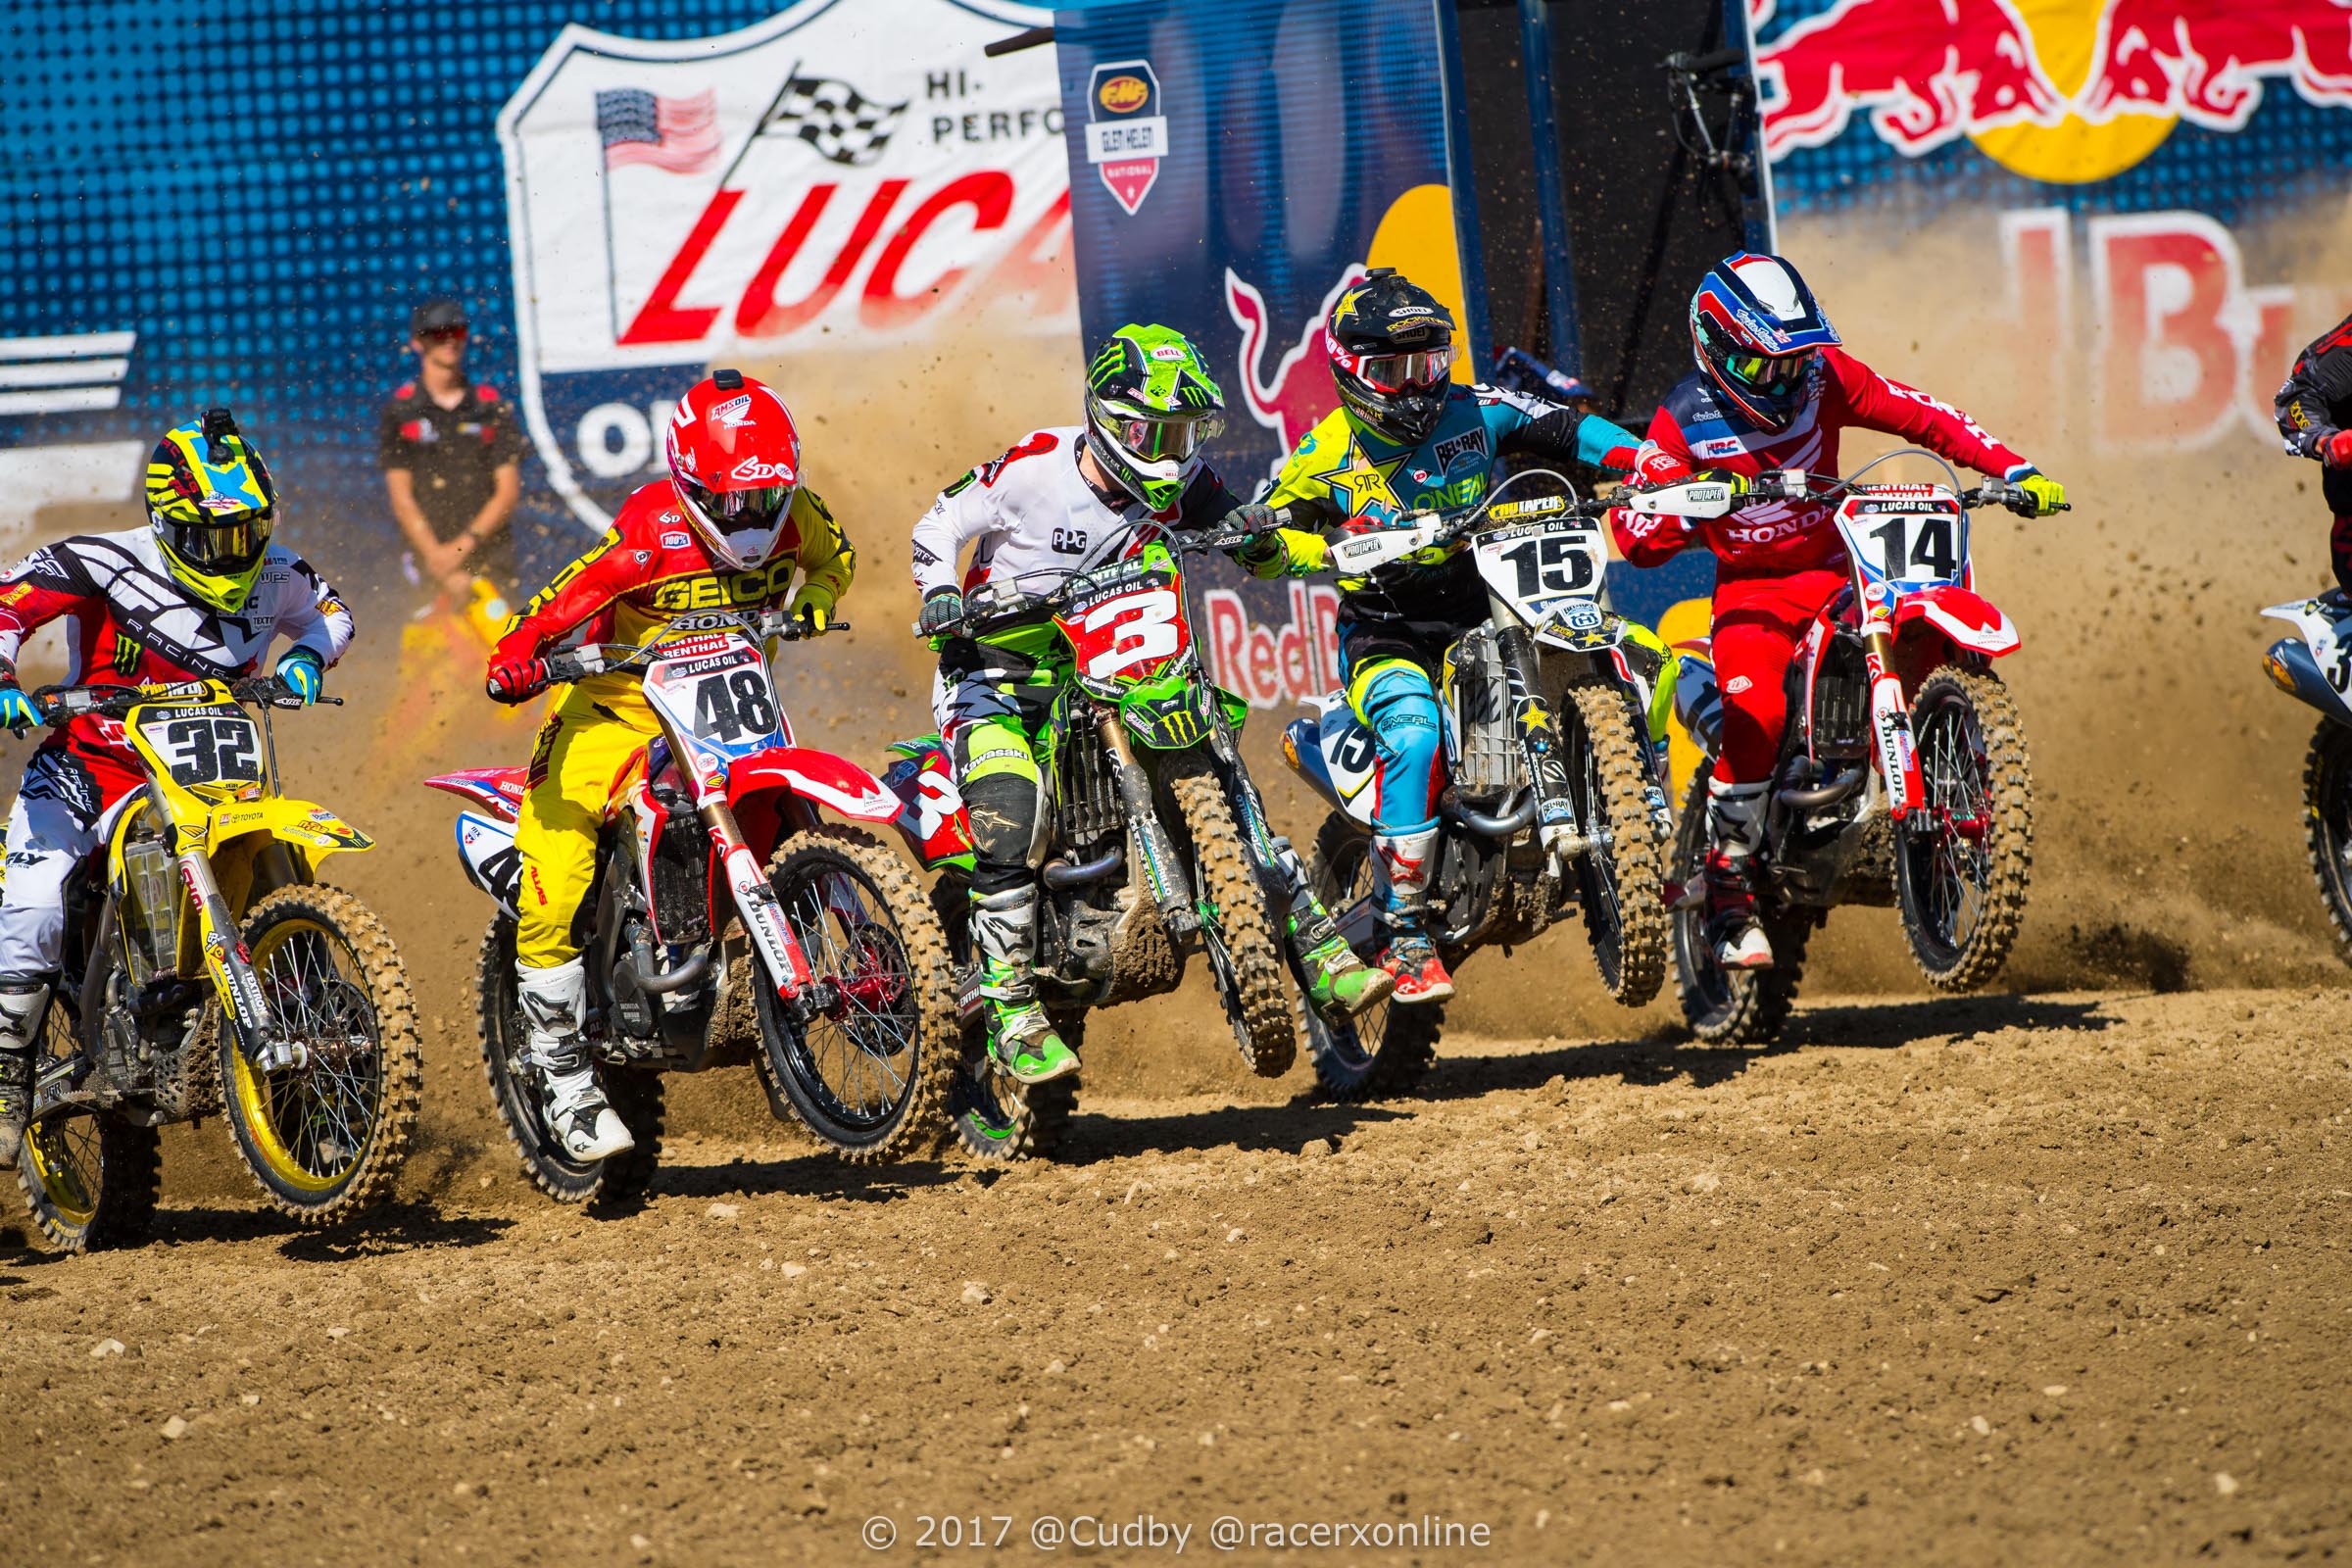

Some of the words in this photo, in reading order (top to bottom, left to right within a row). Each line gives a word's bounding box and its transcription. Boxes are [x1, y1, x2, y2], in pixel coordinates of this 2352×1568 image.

[1106, 163, 1152, 177] NATIONAL
[1396, 307, 1428, 316] SHOEI
[1156, 349, 1181, 358] BELL
[713, 395, 751, 419] AMSOIL
[723, 419, 757, 429] HONDA
[1706, 439, 1740, 456] HRC
[1689, 489, 1722, 501] PROTAPER
[1882, 502, 1916, 513] LUCAS
[1918, 503, 1934, 513] OIL
[1548, 521, 1565, 531] OIL
[1727, 504, 1834, 543] HONDA
[664, 535, 687, 546] 100%
[1346, 539, 1380, 558] PROTAPER
[1870, 517, 1958, 581] 14
[1501, 536, 1593, 598] 15
[259, 571, 290, 584] WPS
[653, 559, 797, 610] GEICO
[1090, 586, 1123, 607] LUCAS
[1125, 581, 1144, 592] OIL
[1084, 590, 1178, 679] 3
[126, 618, 226, 678] RACING
[663, 641, 728, 658] RENTHAL
[1204, 580, 1313, 710] Red
[689, 658, 721, 673] LUCAS
[721, 656, 737, 665] OIL
[1082, 676, 1121, 694] Kawasaki
[174, 708, 207, 717] LUCAS
[208, 707, 223, 716] OIL
[694, 669, 777, 744] 48
[168, 719, 260, 786] 32
[1882, 724, 1904, 798] DUNLOP
[960, 748, 1029, 777] Kawasaki
[240, 812, 264, 821] TOYOTA
[864, 804, 895, 814] HONDA
[748, 901, 794, 974] DUNLOP
[222, 963, 253, 1029] DUNLOP
[247, 970, 268, 1014] TEXTRON
